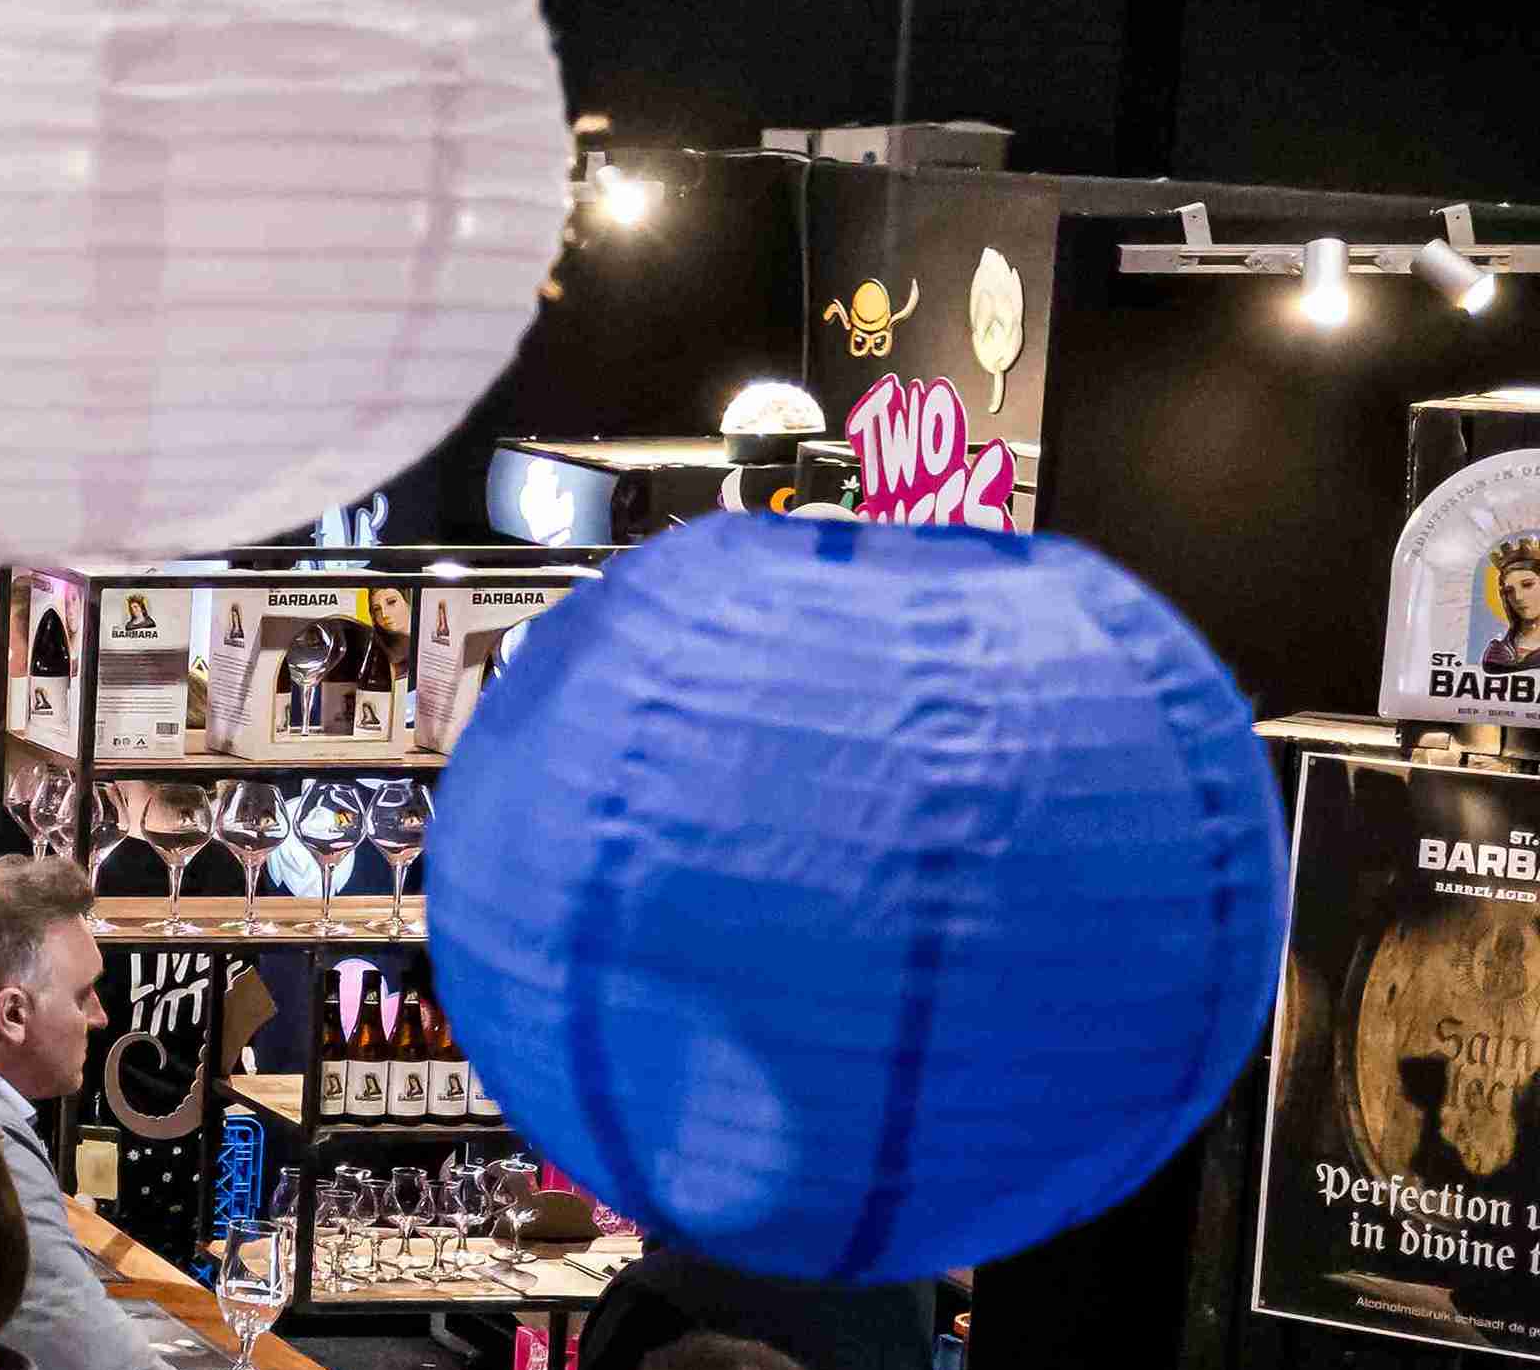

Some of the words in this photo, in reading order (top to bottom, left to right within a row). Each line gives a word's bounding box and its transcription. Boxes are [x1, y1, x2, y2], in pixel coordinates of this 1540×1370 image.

[848, 381, 956, 497] TWO
[268, 593, 339, 607] BARBARA
[472, 592, 546, 606] BARBARA
[111, 630, 159, 639] BARBARA
[1431, 653, 1462, 667] ST.
[1429, 669, 1540, 704] BARB
[1509, 830, 1540, 847] ST.
[1418, 838, 1540, 881] BARB
[1434, 881, 1493, 898] BARREL
[1494, 888, 1537, 903] AGED
[1316, 1163, 1512, 1227] Perfection
[1349, 1211, 1386, 1251] in
[1398, 1219, 1517, 1271] divine
